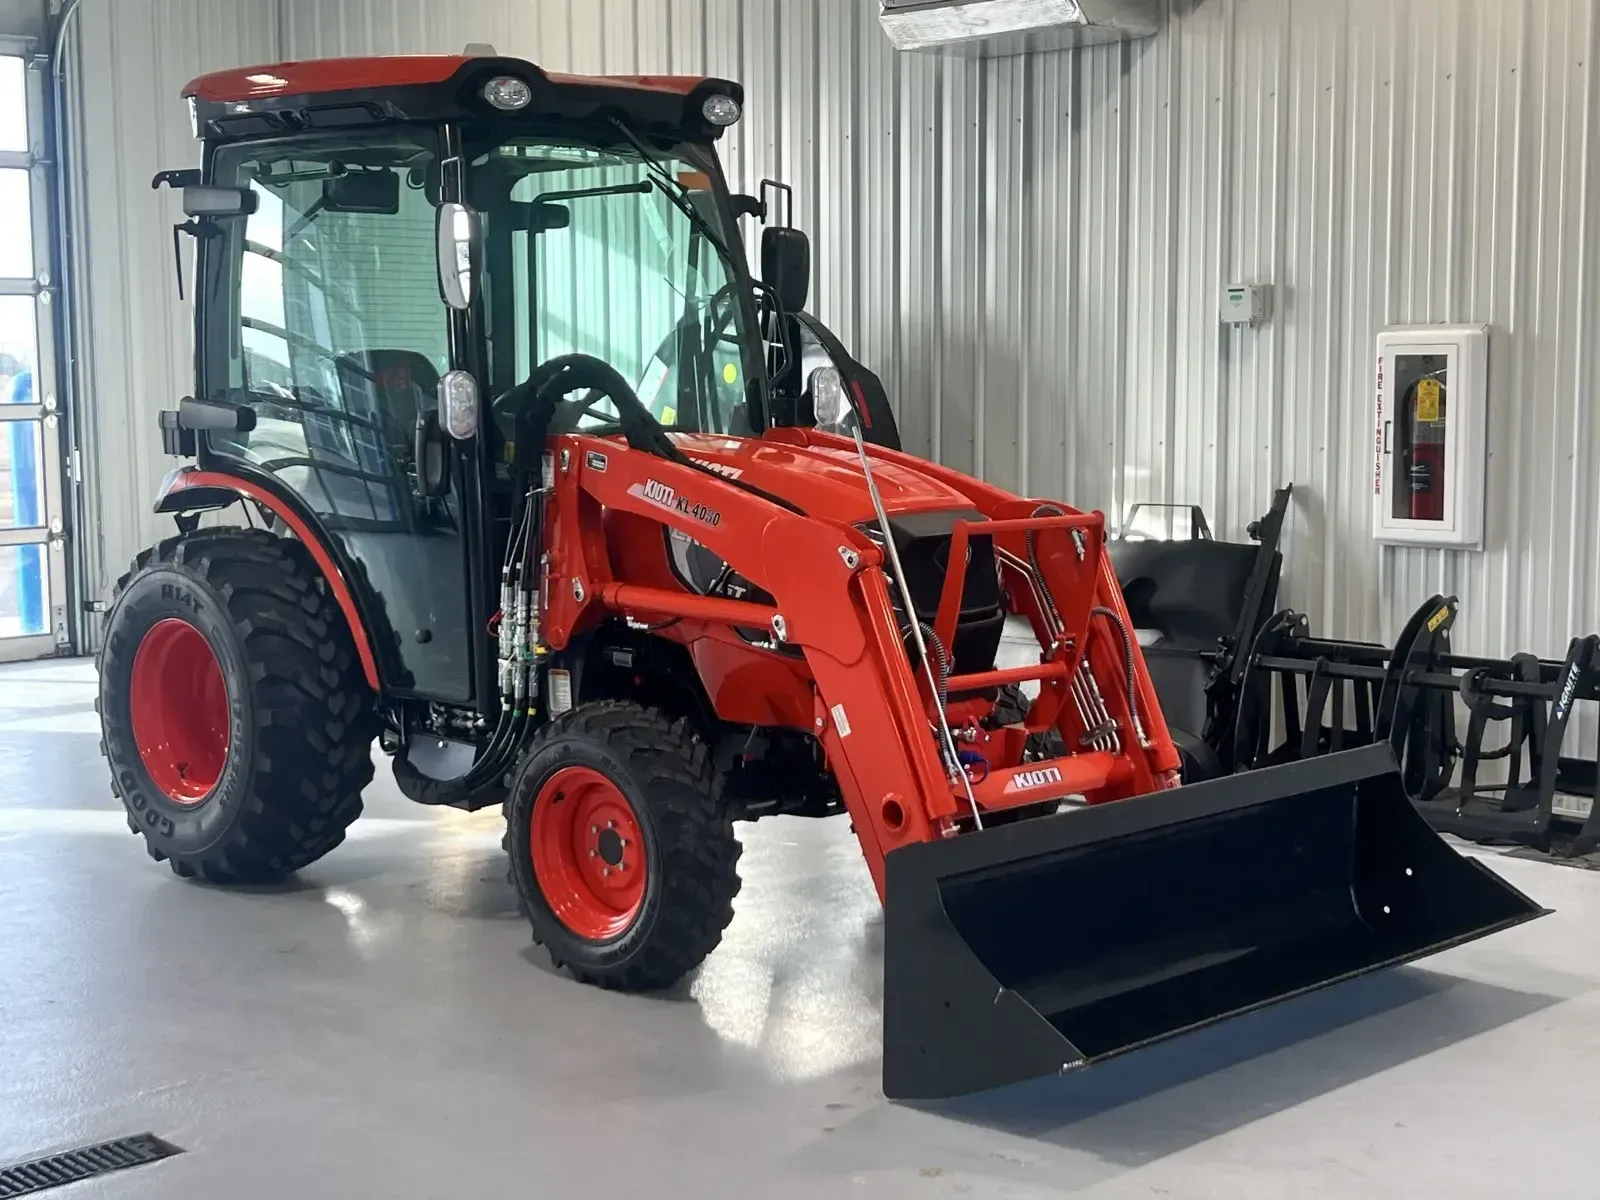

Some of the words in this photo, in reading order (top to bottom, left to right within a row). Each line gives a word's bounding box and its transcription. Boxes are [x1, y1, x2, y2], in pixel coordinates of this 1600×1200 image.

[1375, 394, 1383, 495] EXTINGUISHER
[643, 477, 675, 507] KIOTI
[1559, 661, 1579, 710] IGNITE
[1012, 766, 1062, 789] KIOTI
